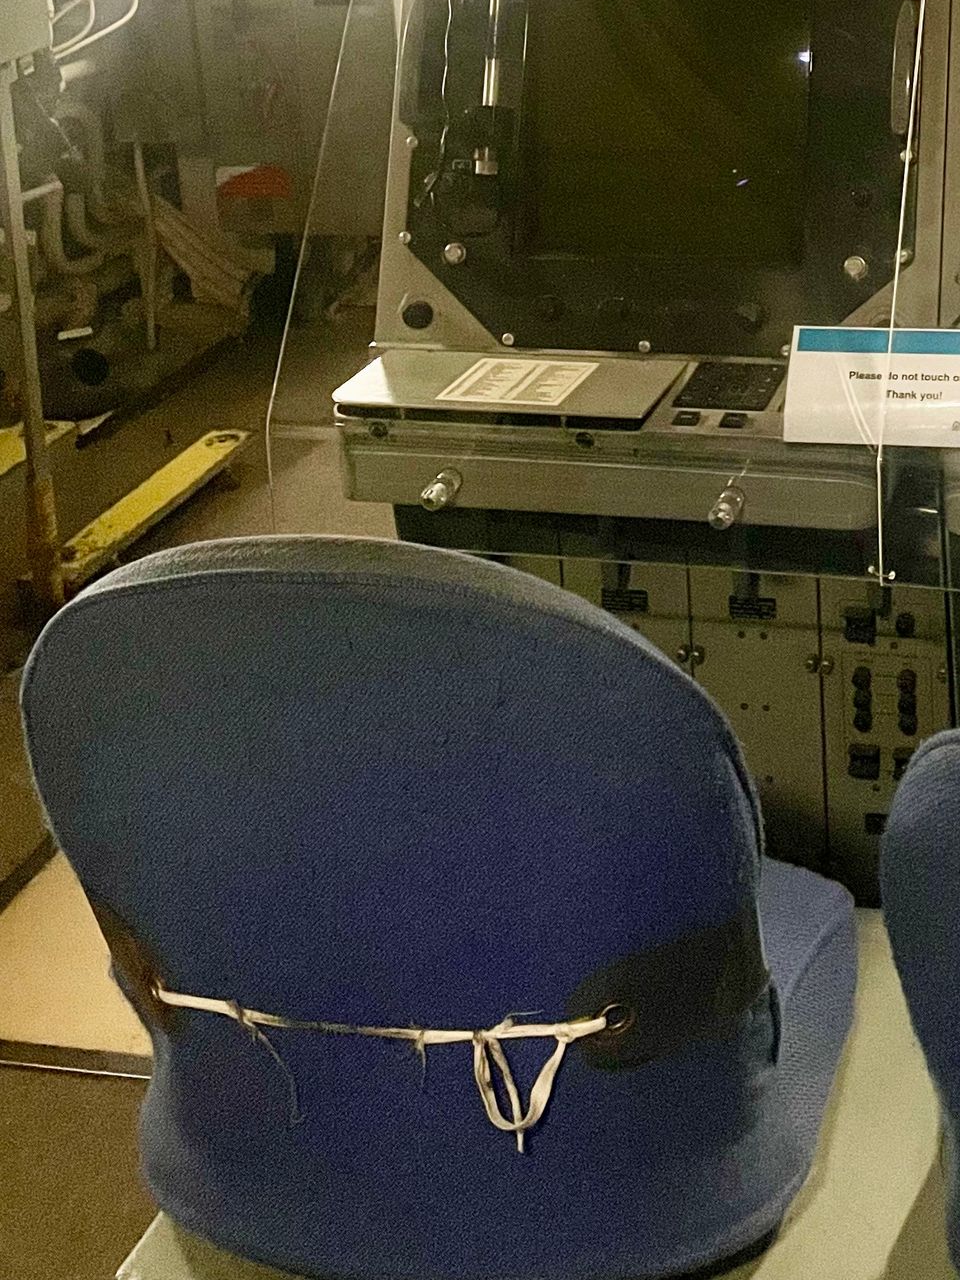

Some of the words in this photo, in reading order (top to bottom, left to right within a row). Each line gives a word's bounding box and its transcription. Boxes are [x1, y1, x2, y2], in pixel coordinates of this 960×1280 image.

[849, 371, 882, 380] Please
[901, 372, 918, 381] not
[921, 373, 950, 382] touch
[886, 389, 917, 400] Thank
[920, 391, 943, 402] you!
